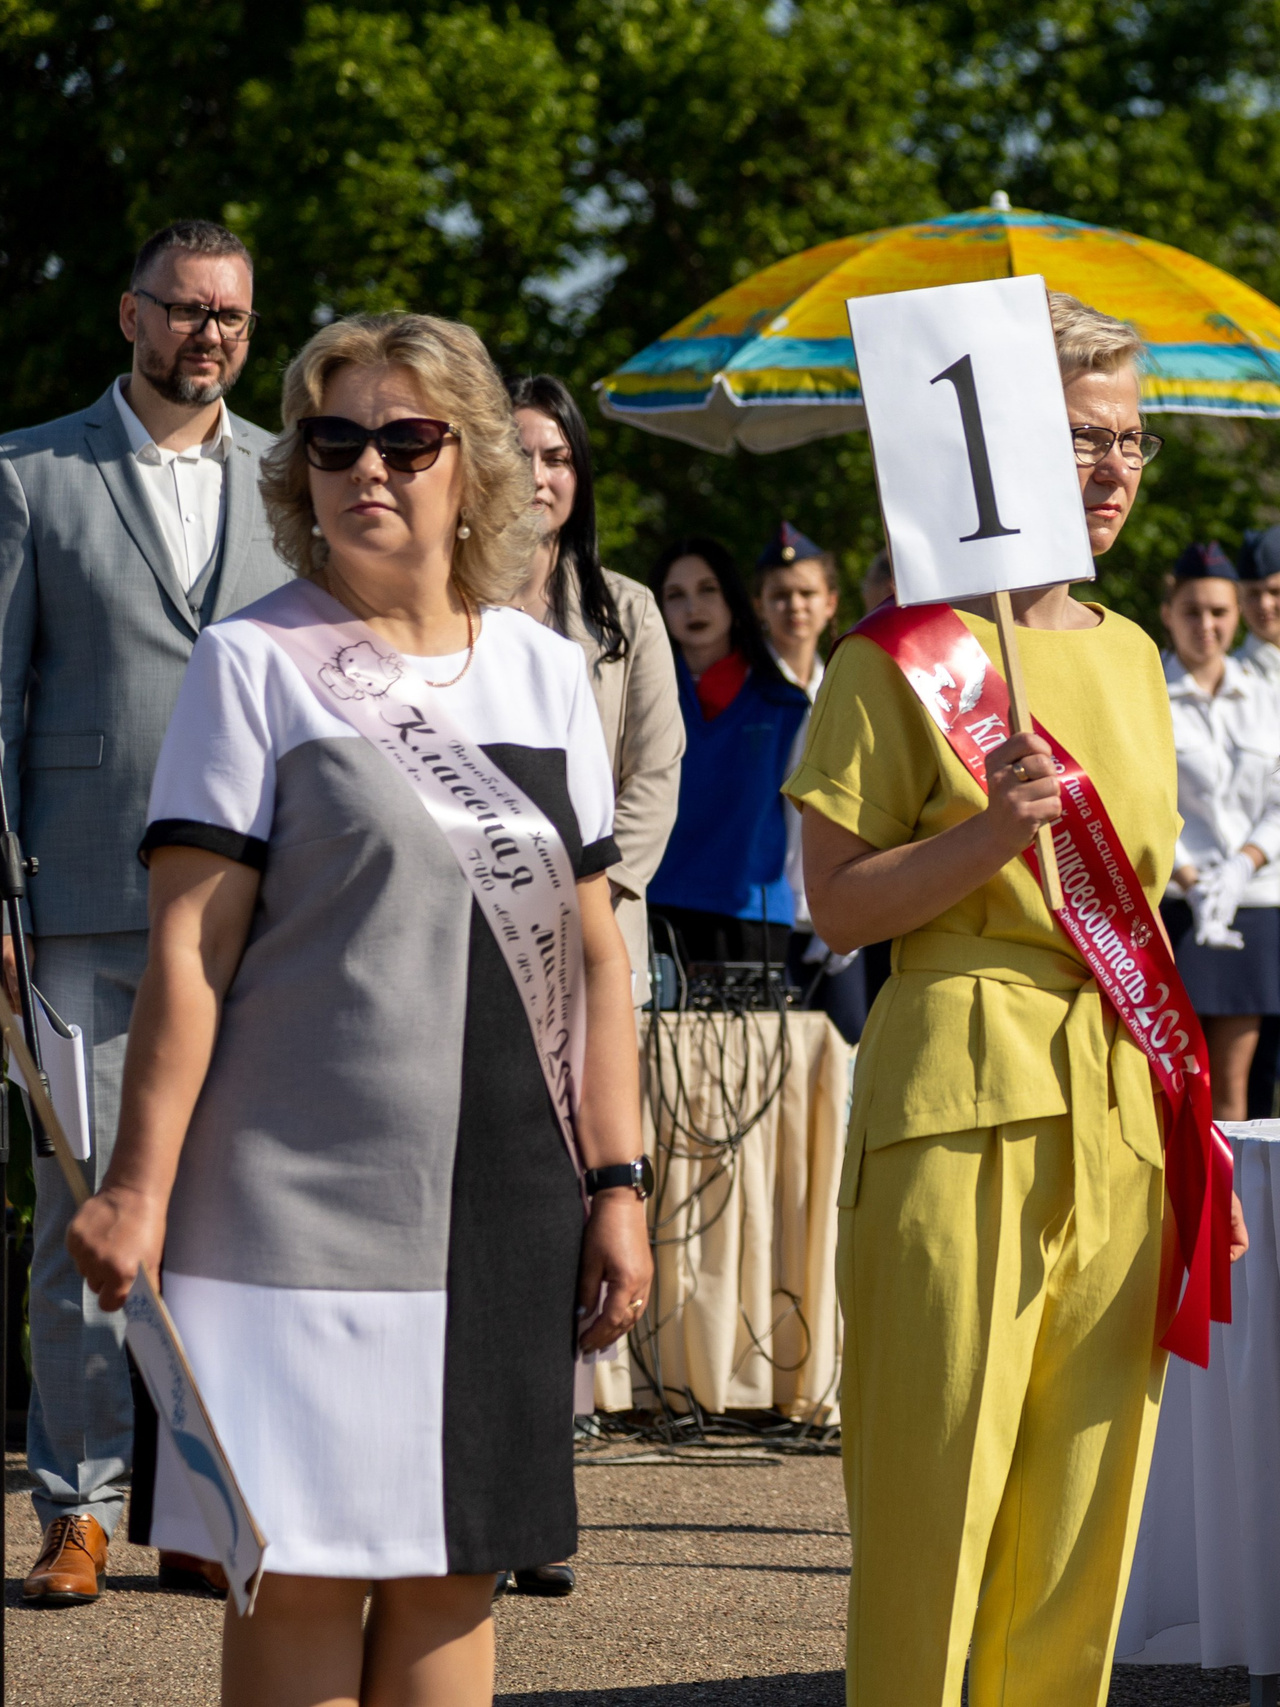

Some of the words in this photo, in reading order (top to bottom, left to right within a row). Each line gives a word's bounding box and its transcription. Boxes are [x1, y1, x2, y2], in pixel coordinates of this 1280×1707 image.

[930, 354, 1021, 543] 1
[380, 704, 534, 894] Классная
[531, 923, 556, 1032] Мама
[467, 848, 496, 891] ГУО
[528, 831, 561, 890] Жанна
[1086, 819, 1136, 914] Васильевна
[1087, 952, 1112, 986] школа
[1110, 984, 1126, 1006] №8
